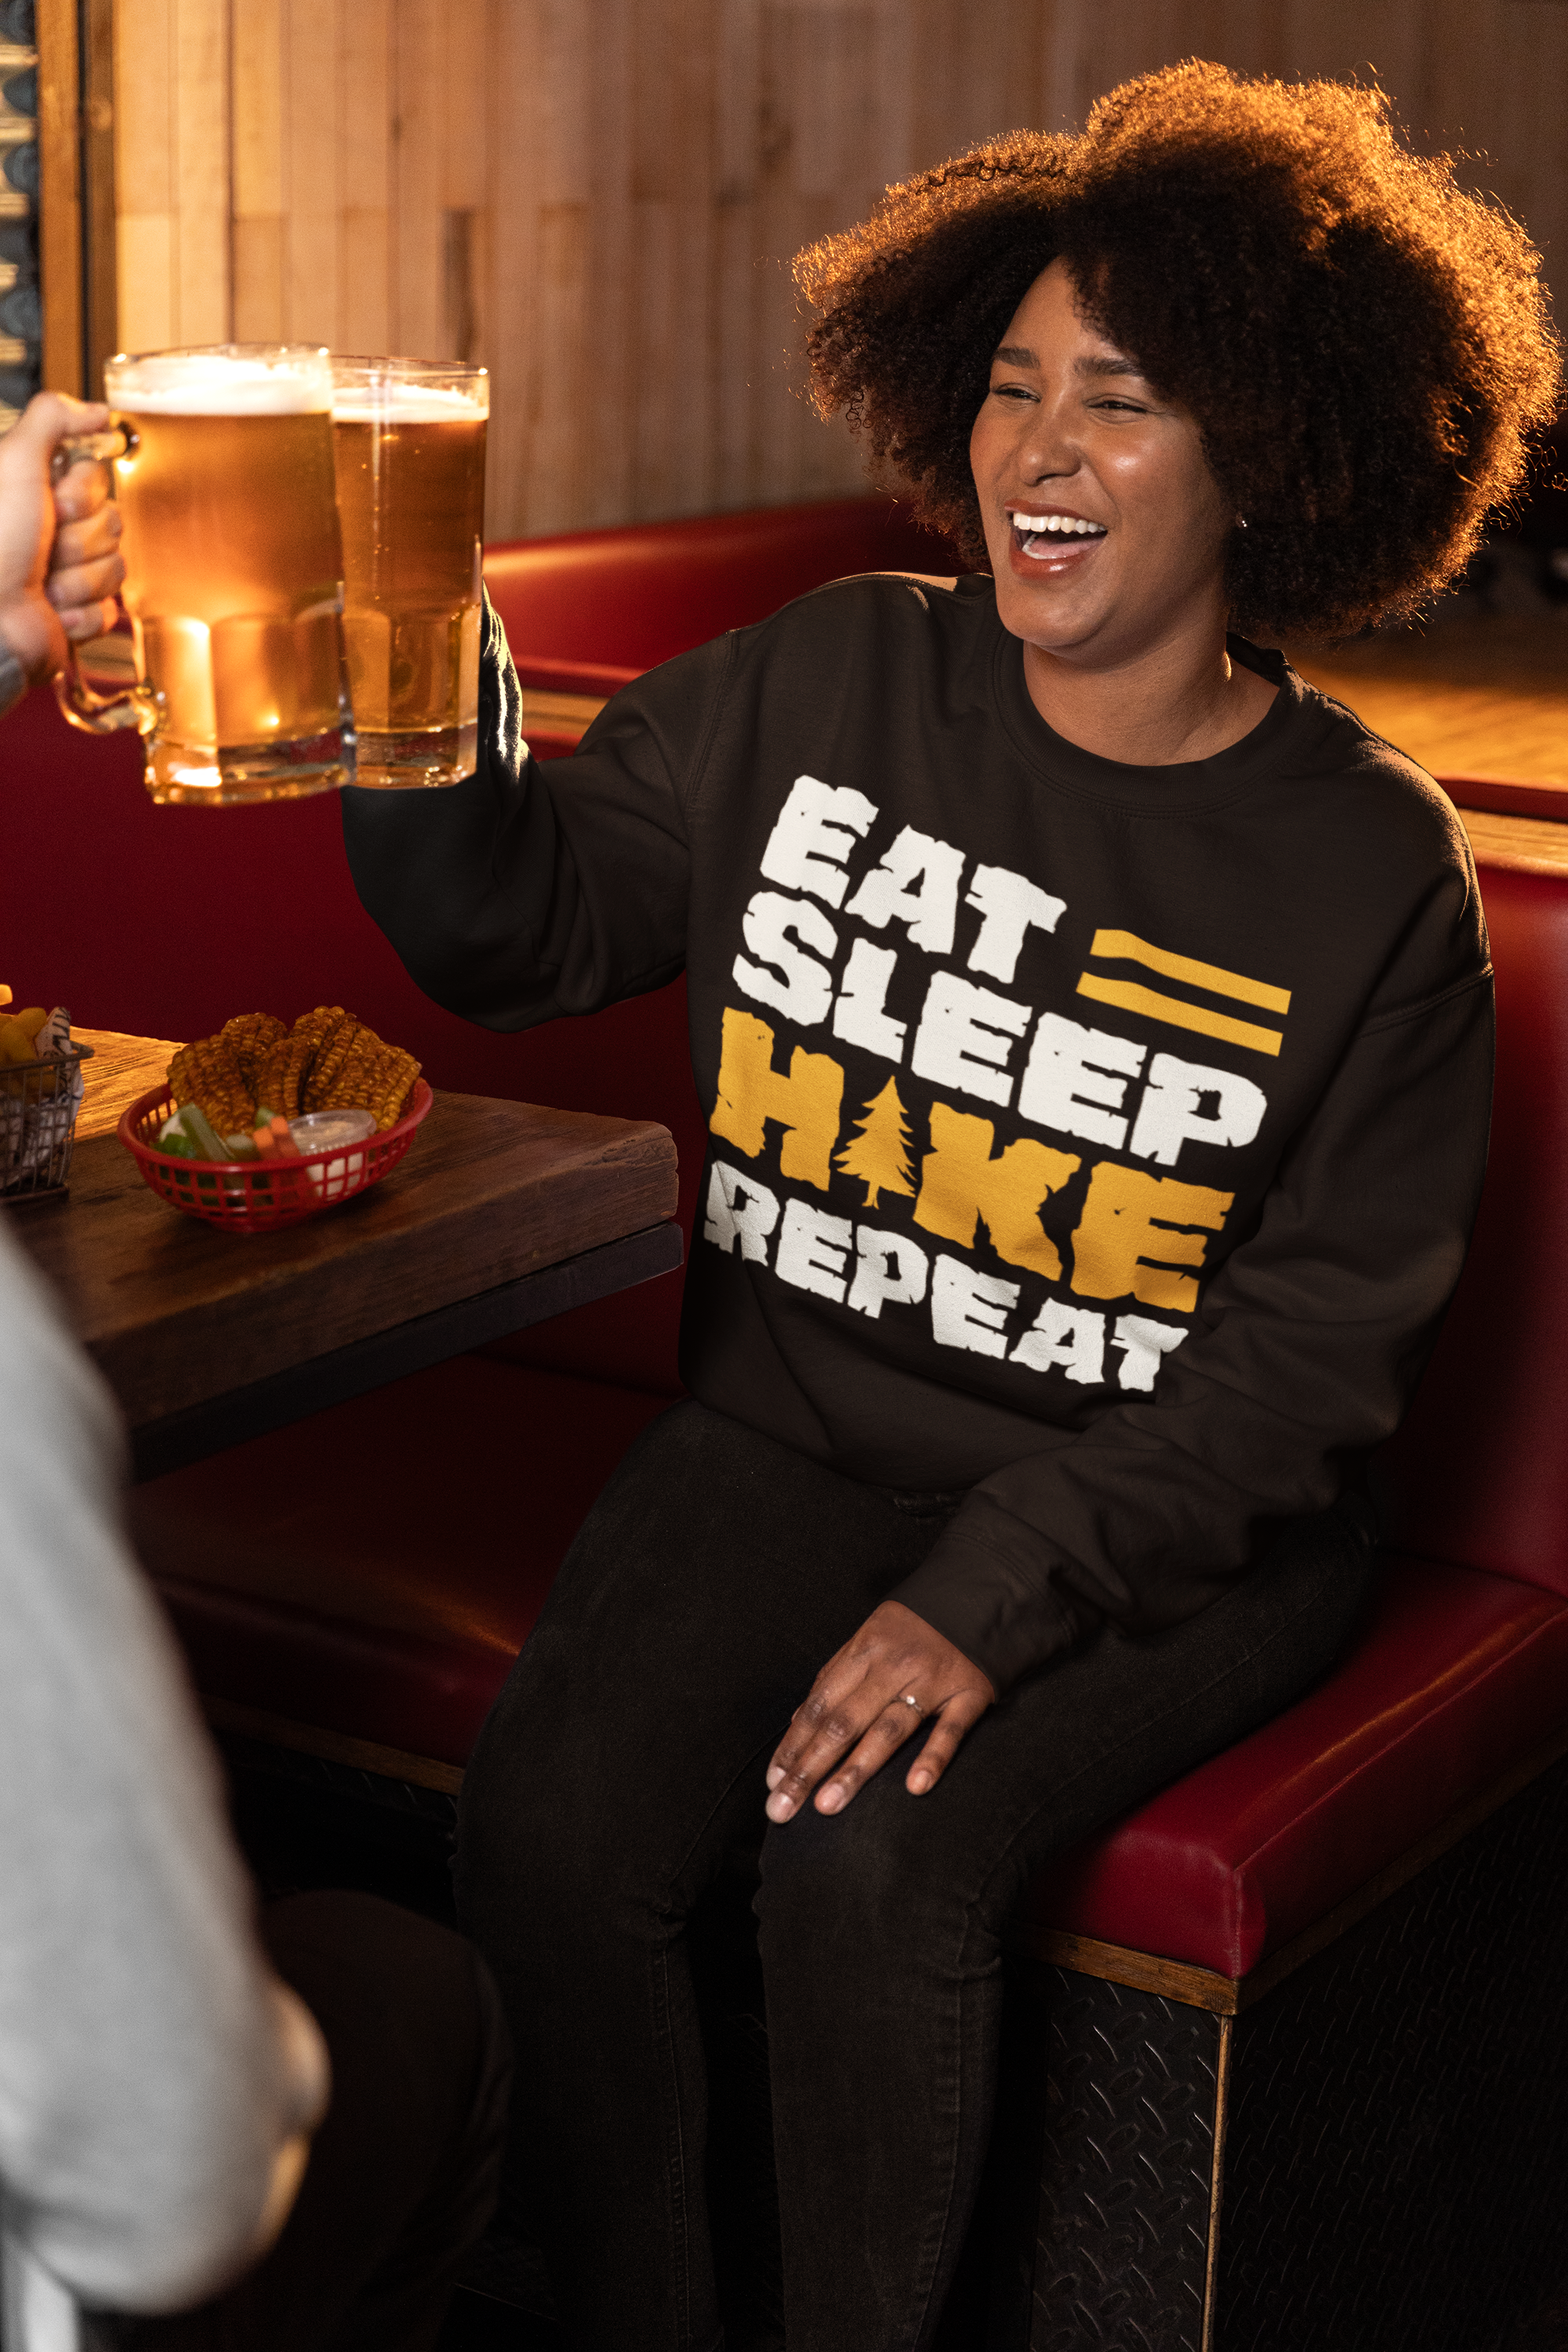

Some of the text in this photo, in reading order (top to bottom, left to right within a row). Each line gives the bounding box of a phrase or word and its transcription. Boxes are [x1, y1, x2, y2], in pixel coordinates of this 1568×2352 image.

[760, 774, 1068, 985] EAT
[732, 891, 1268, 1167] SLEEP
[703, 1160, 1189, 1392] REPEAT
